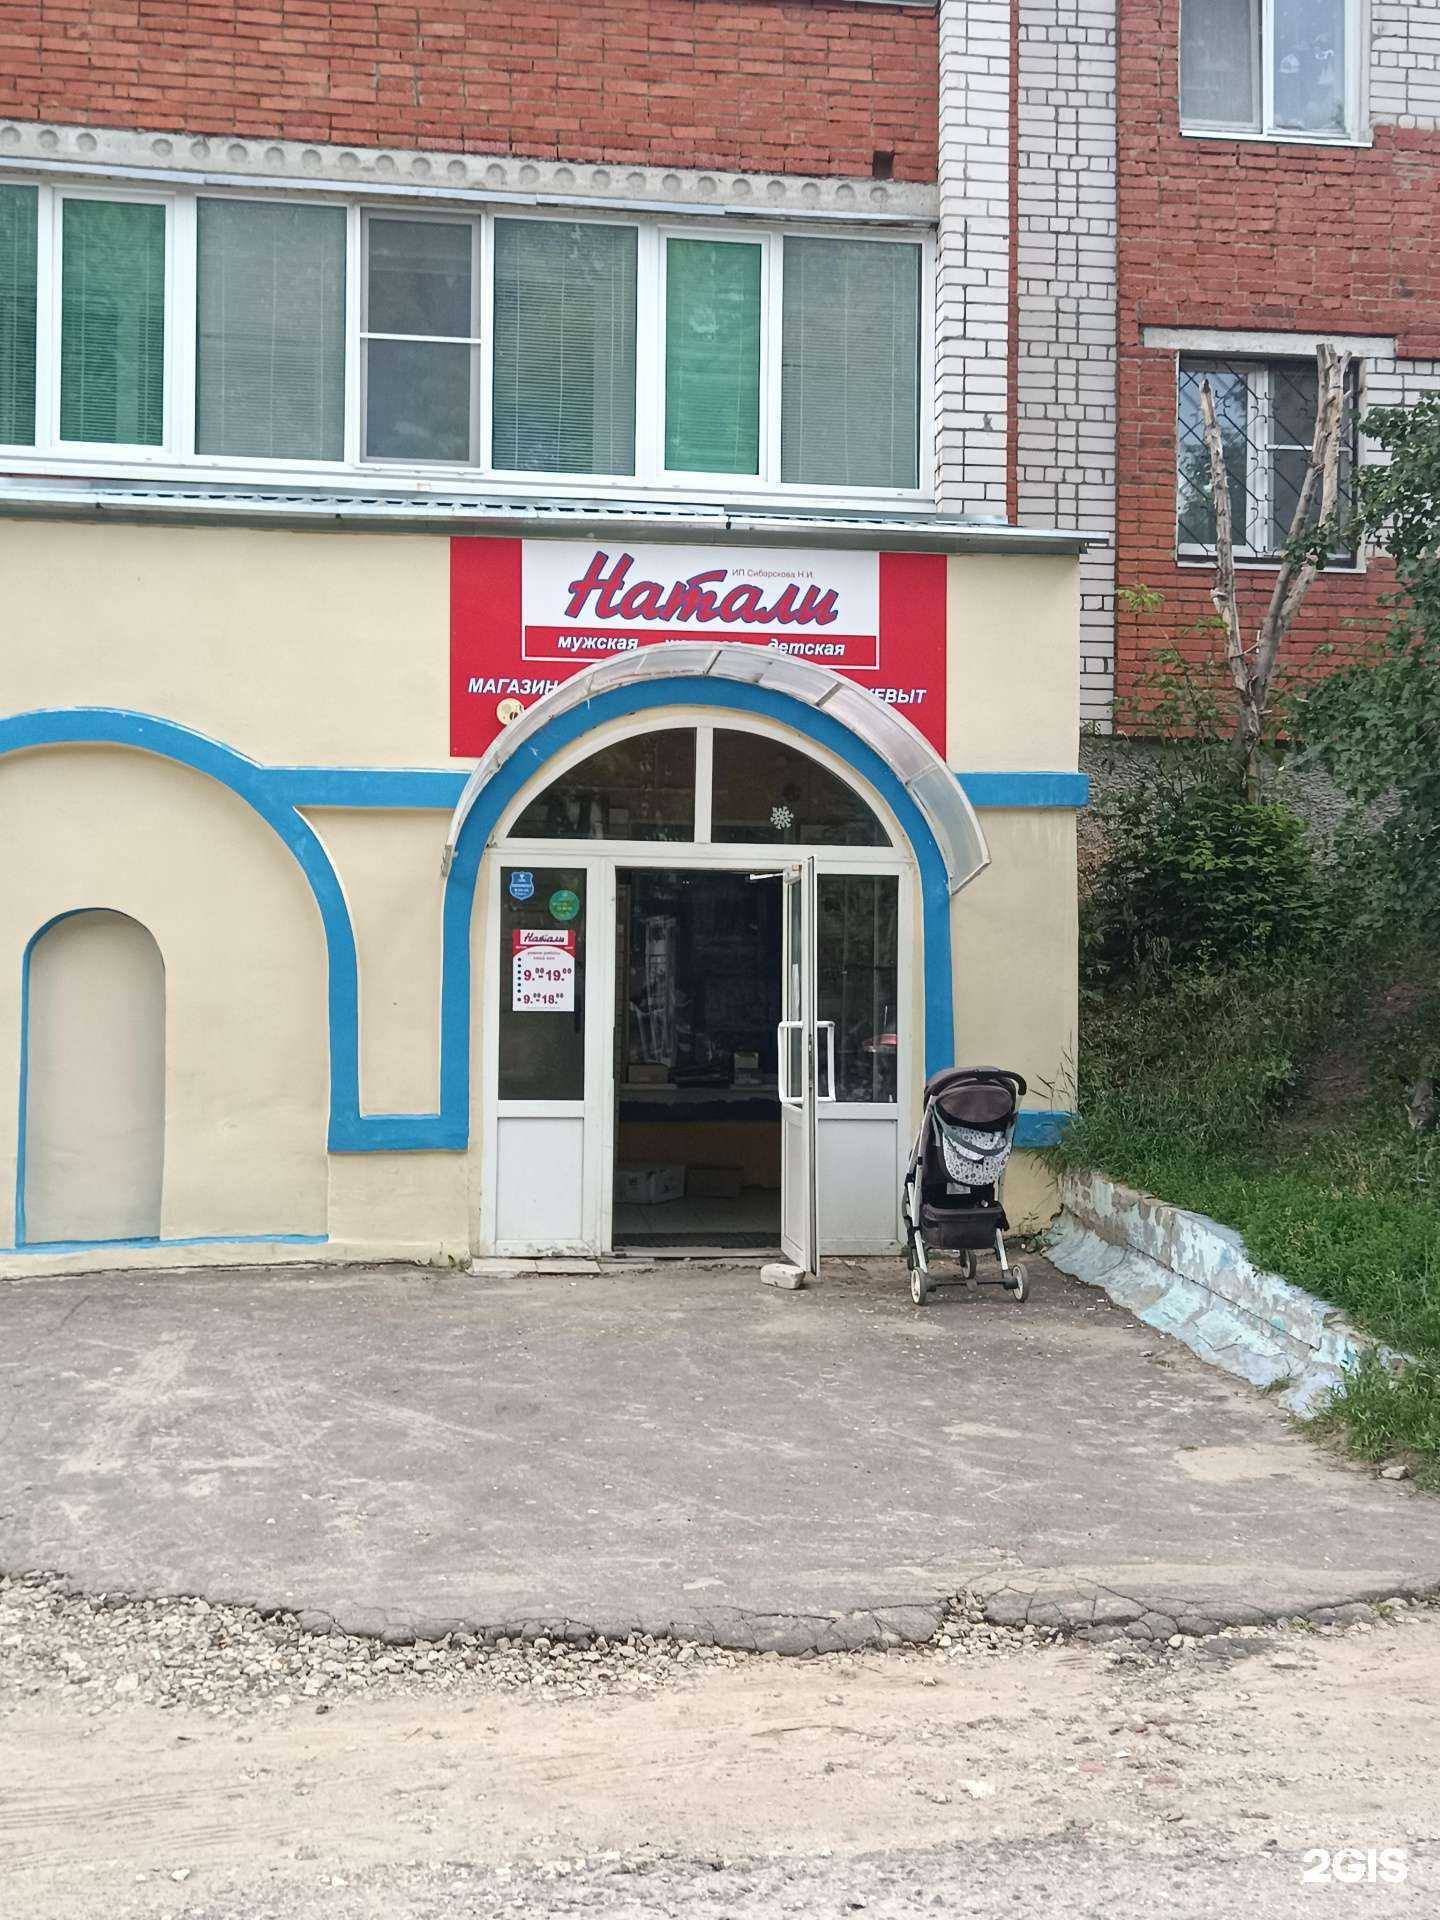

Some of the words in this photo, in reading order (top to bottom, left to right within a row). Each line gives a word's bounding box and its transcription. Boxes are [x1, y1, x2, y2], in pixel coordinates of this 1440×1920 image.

[731, 568, 745, 577] ИП
[565, 550, 839, 625] Натали
[557, 635, 639, 652] мужская
[768, 637, 846, 656] детская
[468, 677, 560, 696] МАГАЗИН
[523, 931, 565, 943] Натали
